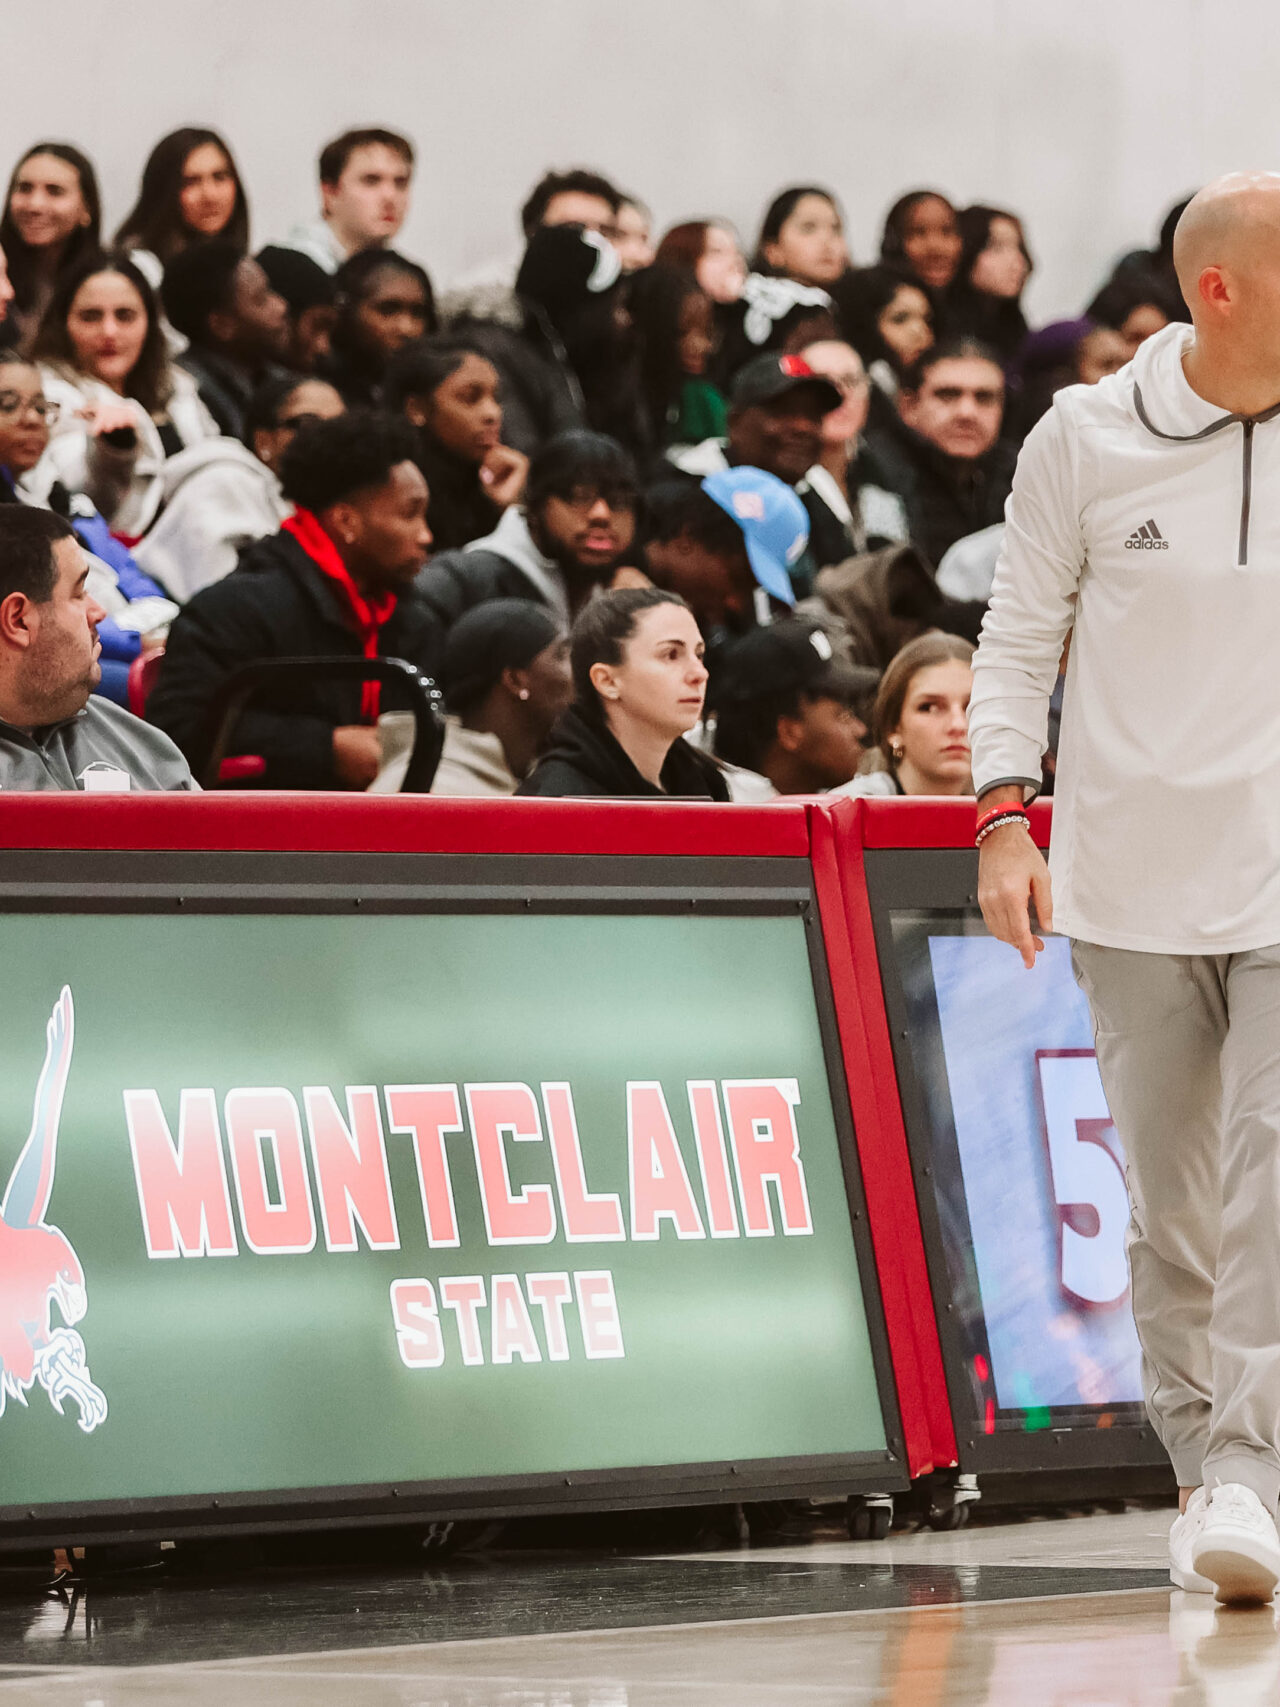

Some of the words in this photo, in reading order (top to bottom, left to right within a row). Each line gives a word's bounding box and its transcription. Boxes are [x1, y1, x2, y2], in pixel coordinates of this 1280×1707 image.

[1124, 537, 1170, 550] adidas
[123, 1078, 814, 1259] MONTCLAIR
[389, 1270, 625, 1368] STATE
